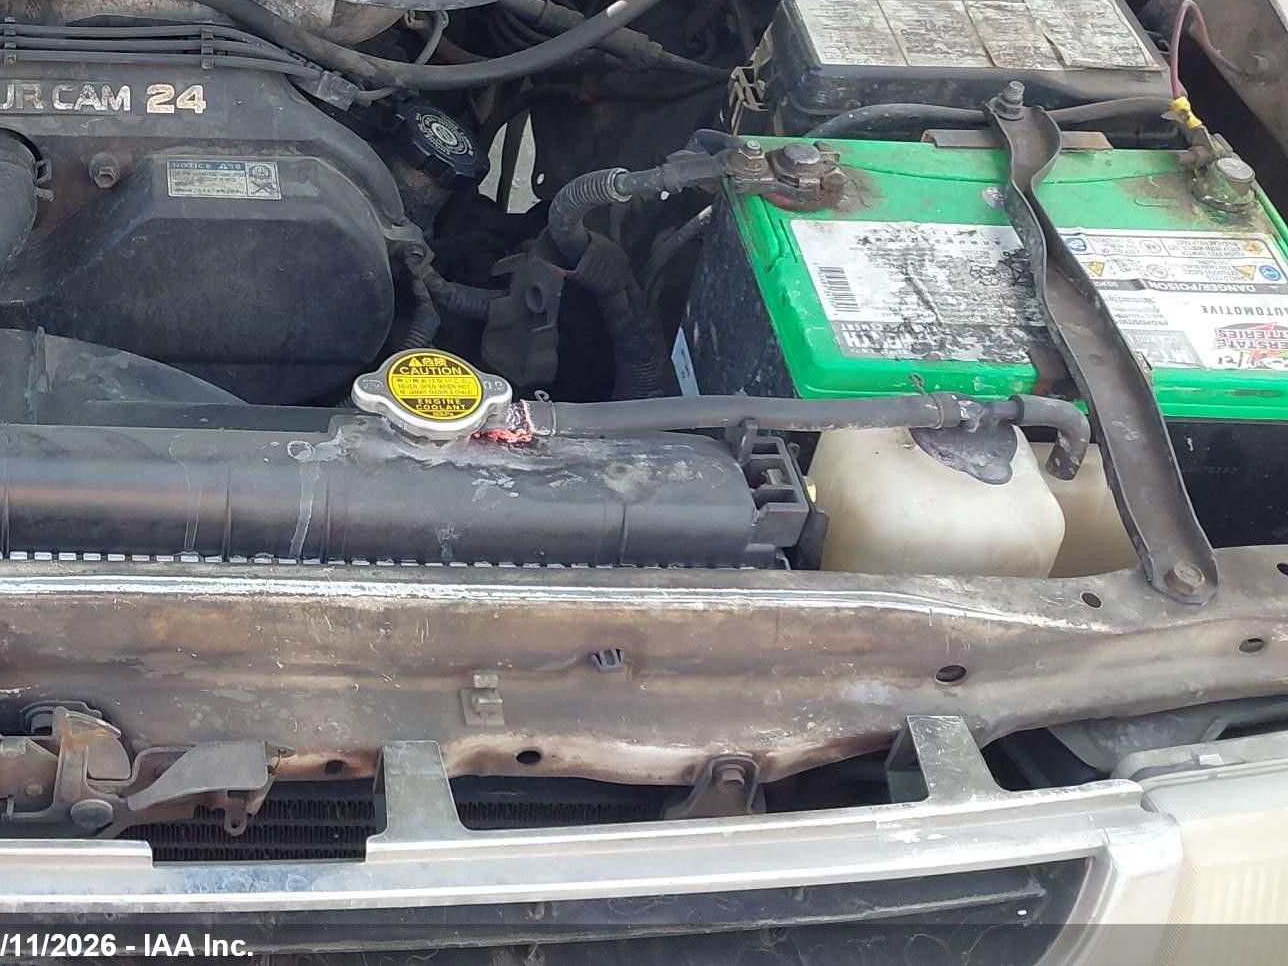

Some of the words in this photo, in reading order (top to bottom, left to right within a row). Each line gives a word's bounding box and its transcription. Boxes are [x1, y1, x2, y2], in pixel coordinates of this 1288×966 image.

[50, 83, 132, 112] CAM
[146, 84, 208, 114] 24
[171, 162, 212, 170] NOTICE
[1148, 280, 1257, 293] DANGER/POISON
[399, 366, 462, 375] CAUTION
